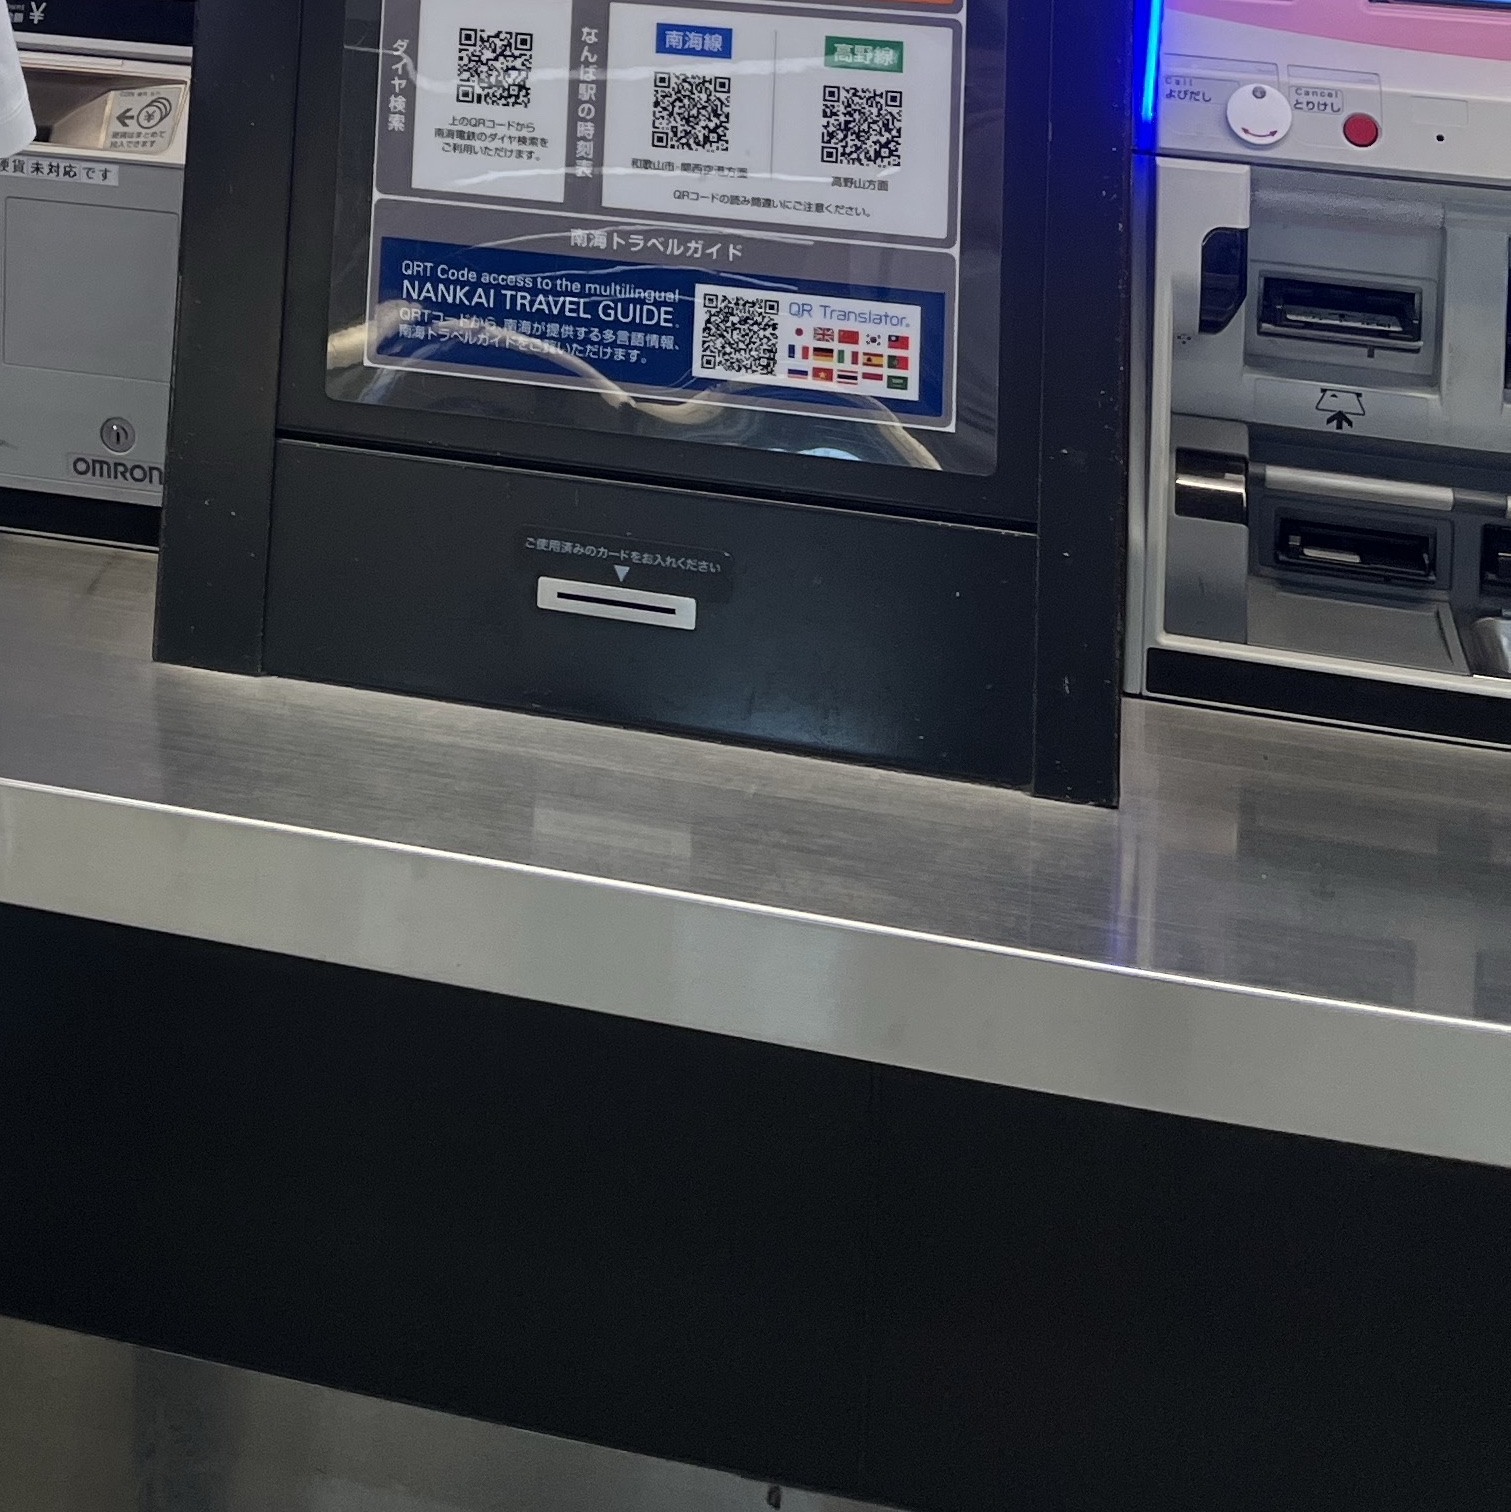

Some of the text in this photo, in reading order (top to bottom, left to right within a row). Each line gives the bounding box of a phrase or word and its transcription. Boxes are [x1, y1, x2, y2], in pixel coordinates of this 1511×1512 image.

[664, 29, 723, 52] 南海線
[833, 42, 895, 66] 高野線
[387, 38, 410, 132] ダイヤ検索
[1165, 88, 1212, 104] よびだし
[1294, 87, 1340, 99] Cancel
[574, 26, 598, 178] なんば駅の時刻表
[1293, 99, 1342, 114] とりけし
[830, 176, 890, 192] 高野山方面
[570, 228, 744, 261] 南海トラベルガイド
[401, 260, 680, 304] QRT Code access to the multilingual
[402, 279, 494, 308] NANKAI
[501, 290, 592, 319] TRAVEL
[789, 302, 814, 319] QR
[72, 457, 164, 487] OMRON
[525, 537, 722, 574] ご使用済みのカードをお入れください
